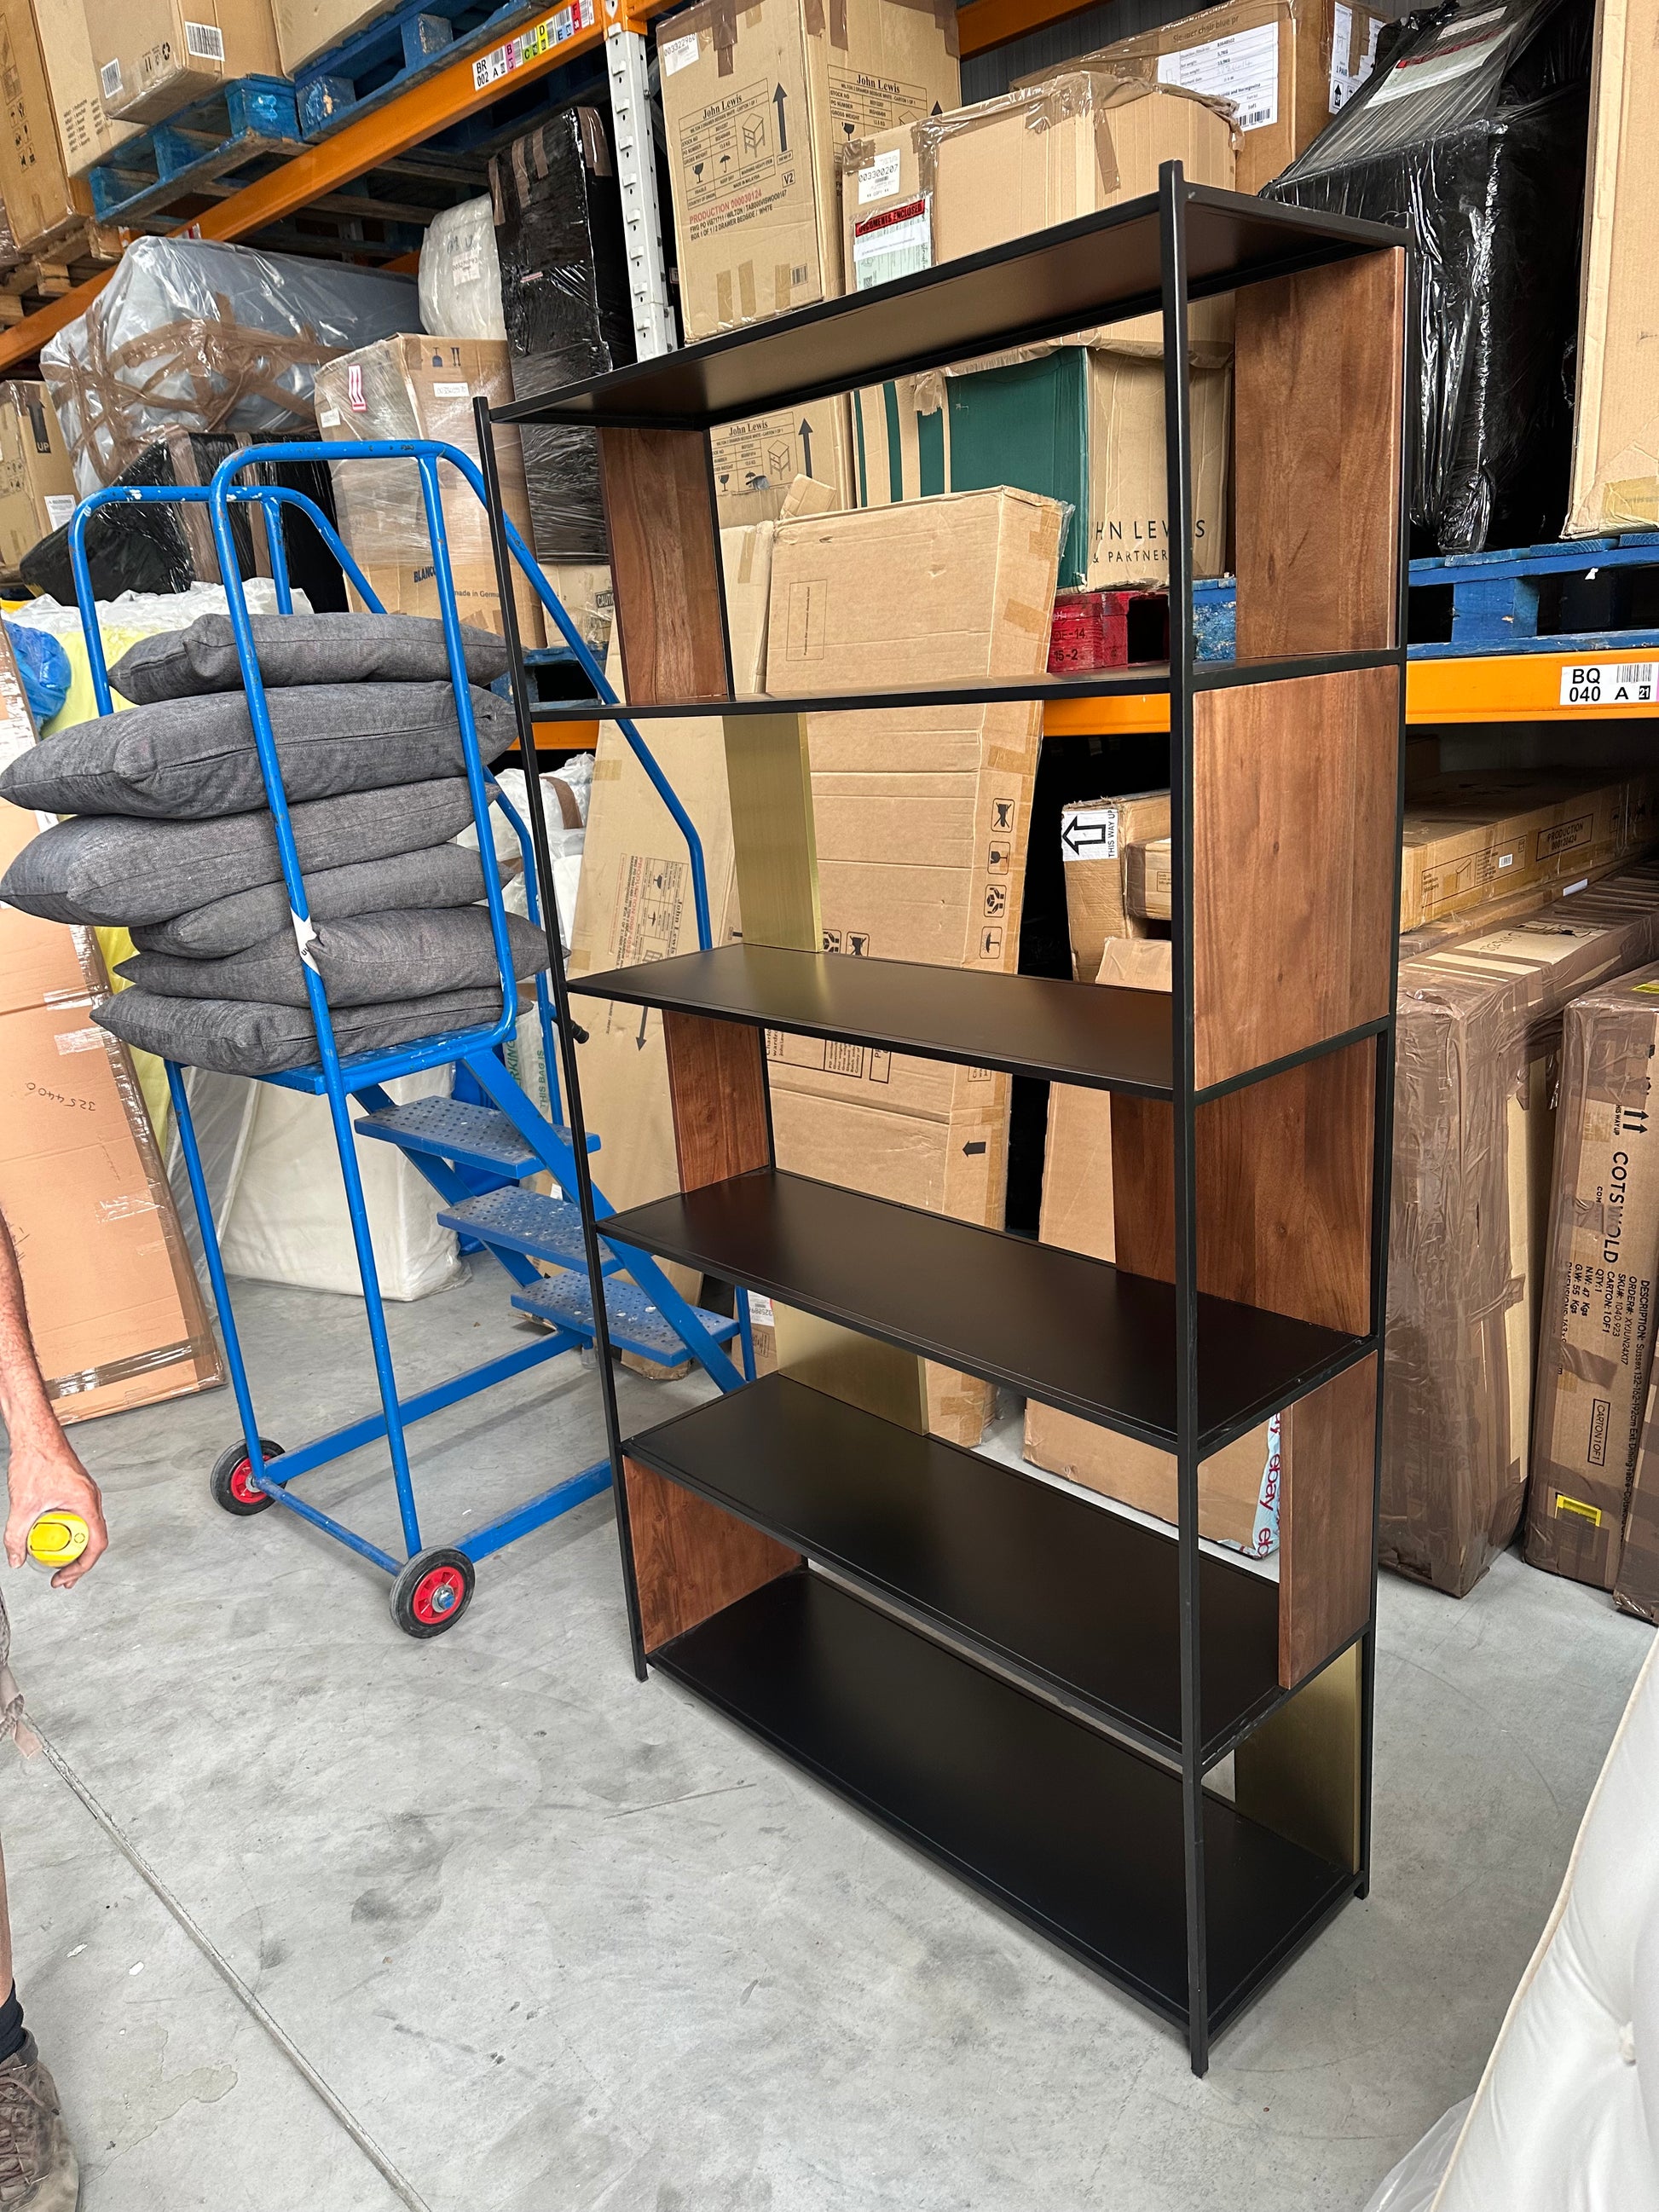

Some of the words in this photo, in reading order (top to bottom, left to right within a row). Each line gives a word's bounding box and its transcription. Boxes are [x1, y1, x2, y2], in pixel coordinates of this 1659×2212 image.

[572, 3, 578, 15] F
[539, 25, 545, 37] D
[1216, 19, 1230, 29] blue
[558, 29, 564, 41] E
[506, 44, 512, 55] B
[524, 49, 530, 60] C
[476, 59, 487, 74] BR
[477, 71, 488, 87] 002
[493, 67, 499, 78] A
[857, 74, 876, 88] John
[878, 78, 900, 94] Lewis
[702, 106, 720, 119] John
[721, 94, 743, 111] Lewis
[837, 101, 853, 109] NUMBER
[783, 172, 794, 185] V2
[858, 164, 899, 183] 003300207
[689, 201, 730, 224] PRODUCTION
[691, 232, 700, 241] BOX
[703, 228, 708, 236] OF
[719, 219, 737, 230] DRAWER
[737, 212, 755, 223] BEDSIDE
[759, 203, 773, 214] WHITE
[727, 207, 743, 218] WILTON
[893, 203, 922, 222] ENCLOSED
[729, 426, 746, 436] John
[747, 419, 768, 432] Lewis
[37, 442, 49, 453] UP
[1095, 520, 1123, 540] HN
[1134, 519, 1205, 539] LES
[1092, 553, 1099, 563] &
[1108, 549, 1168, 563] PARTNER
[1054, 648, 1078, 661] 15-2
[1572, 667, 1601, 684] BQ
[1569, 685, 1601, 702] 040
[1614, 686, 1629, 700] A
[1639, 687, 1650, 698] 21
[1107, 810, 1115, 819] UP
[1547, 819, 1583, 842] PRODUCTION
[632, 857, 643, 914] PRODUCTION
[670, 927, 680, 954] Lewis
[506, 1040, 522, 1088] RKING
[537, 1049, 545, 1060] IS
[1613, 1127, 1620, 1135] UP
[1604, 1151, 1629, 1264] COTSWOLD
[1574, 1263, 1582, 1283] G.W:
[1584, 1266, 1593, 1285] N.W:
[1595, 1268, 1604, 1292] QTY:1
[1572, 1285, 1580, 1296] 55
[1581, 1287, 1590, 1297] 47
[1604, 1271, 1615, 1309] CARTON:
[1616, 1273, 1626, 1298] SKU#:
[1626, 1276, 1637, 1314] ORDER#:
[1570, 1299, 1580, 1314] Kgs
[1581, 1302, 1590, 1317] Kgs
[1637, 1279, 1650, 1341] DESCRIPTION:
[1621, 1317, 1633, 1365] XYJUN24X17
[1635, 1343, 1645, 1371] Sussex
[1625, 1443, 1635, 1468] Dining
[1260, 1453, 1280, 1512] ebay
